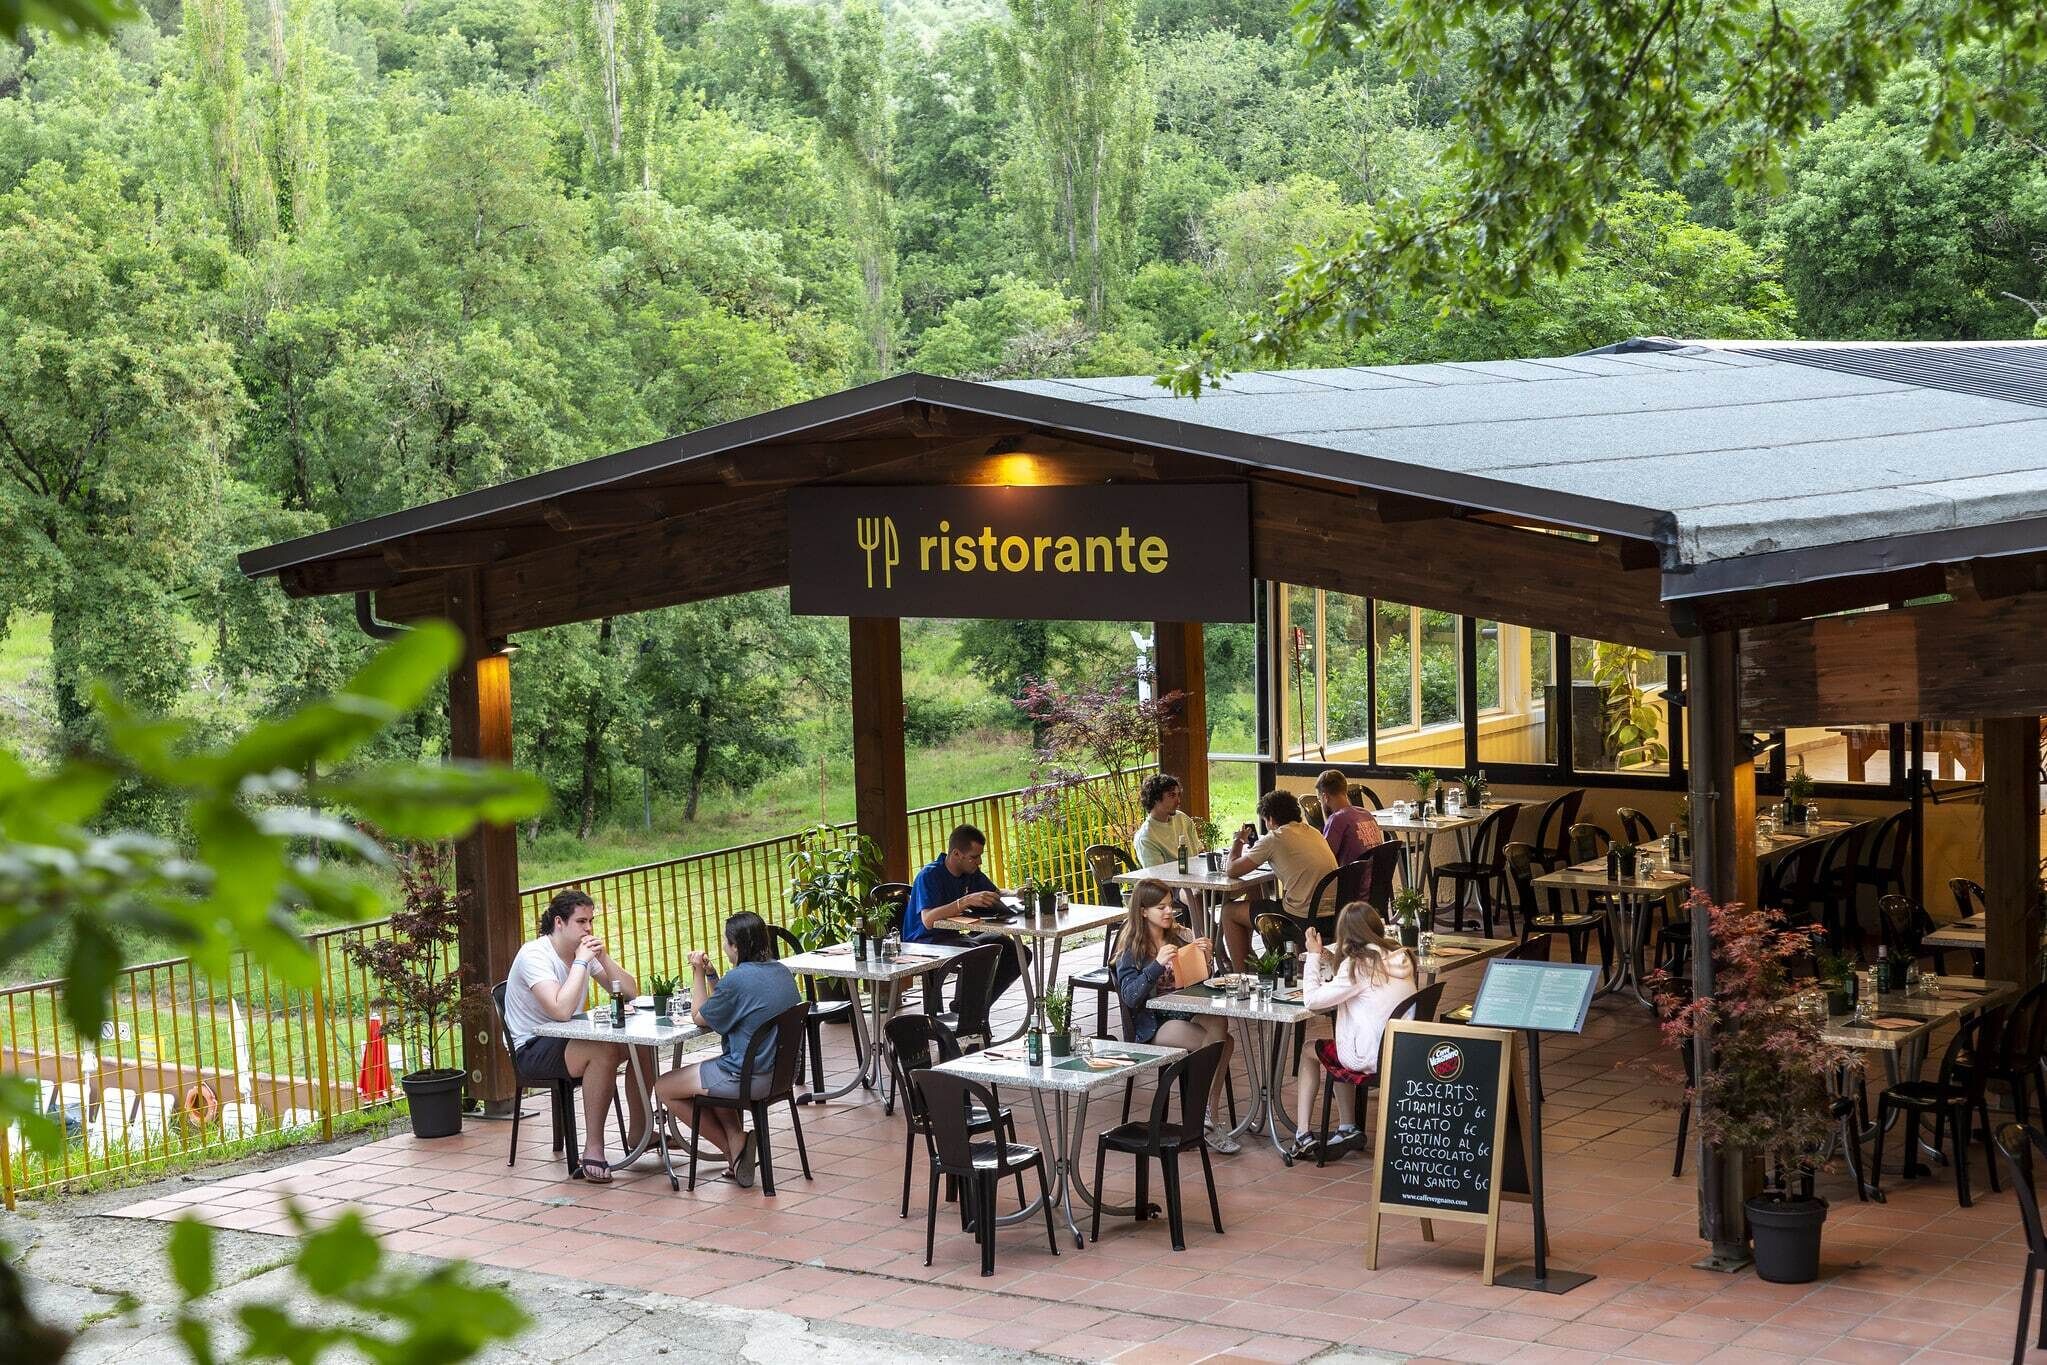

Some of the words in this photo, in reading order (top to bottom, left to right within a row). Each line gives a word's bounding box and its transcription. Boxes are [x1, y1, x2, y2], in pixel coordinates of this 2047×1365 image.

[919, 520, 1169, 574] ristorante
[1405, 1080, 1479, 1101] DESERTS:
[1398, 1116, 1451, 1132] GELATO
[1398, 1132, 1451, 1148] TORTINO
[1458, 1138, 1471, 1150] AL
[1401, 1146, 1475, 1162] CIOCCOLATO
[1394, 1159, 1457, 1177] CANTUCCI
[1401, 1173, 1420, 1185] VIN
[1423, 1176, 1461, 1190] SANTO
